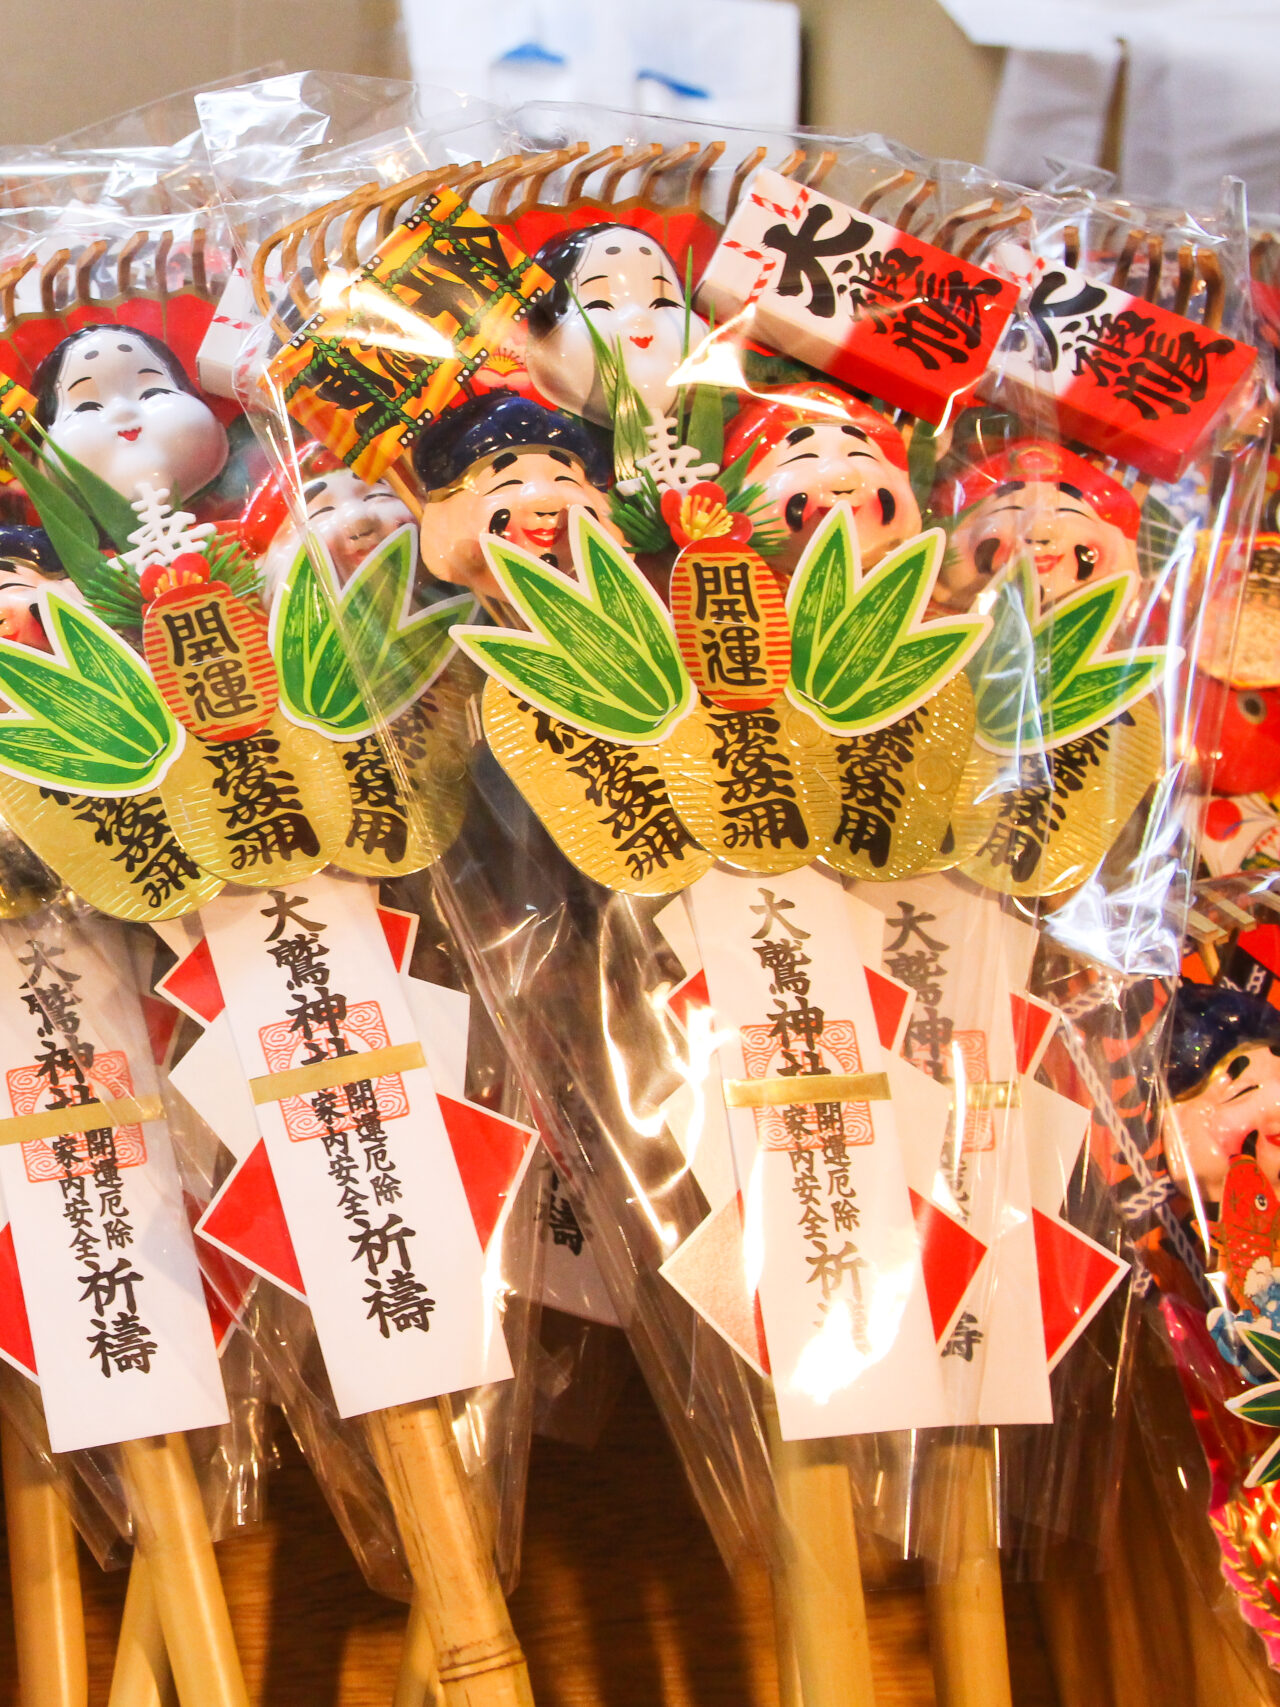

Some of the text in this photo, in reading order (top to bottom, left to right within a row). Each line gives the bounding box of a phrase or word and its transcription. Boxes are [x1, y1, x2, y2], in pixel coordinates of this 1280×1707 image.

[764, 203, 1002, 370] 大福帳
[1029, 271, 1235, 420] 大福帳
[162, 601, 258, 721] 開運
[693, 562, 767, 686] 開運
[52, 1133, 101, 1261] 家内安全
[85, 1127, 134, 1251] 開運厄除
[312, 1086, 370, 1220] 家内安全
[344, 1079, 403, 1207] 開運厄除
[782, 1104, 829, 1240] 家内安全
[814, 1102, 860, 1233] 開運厄除
